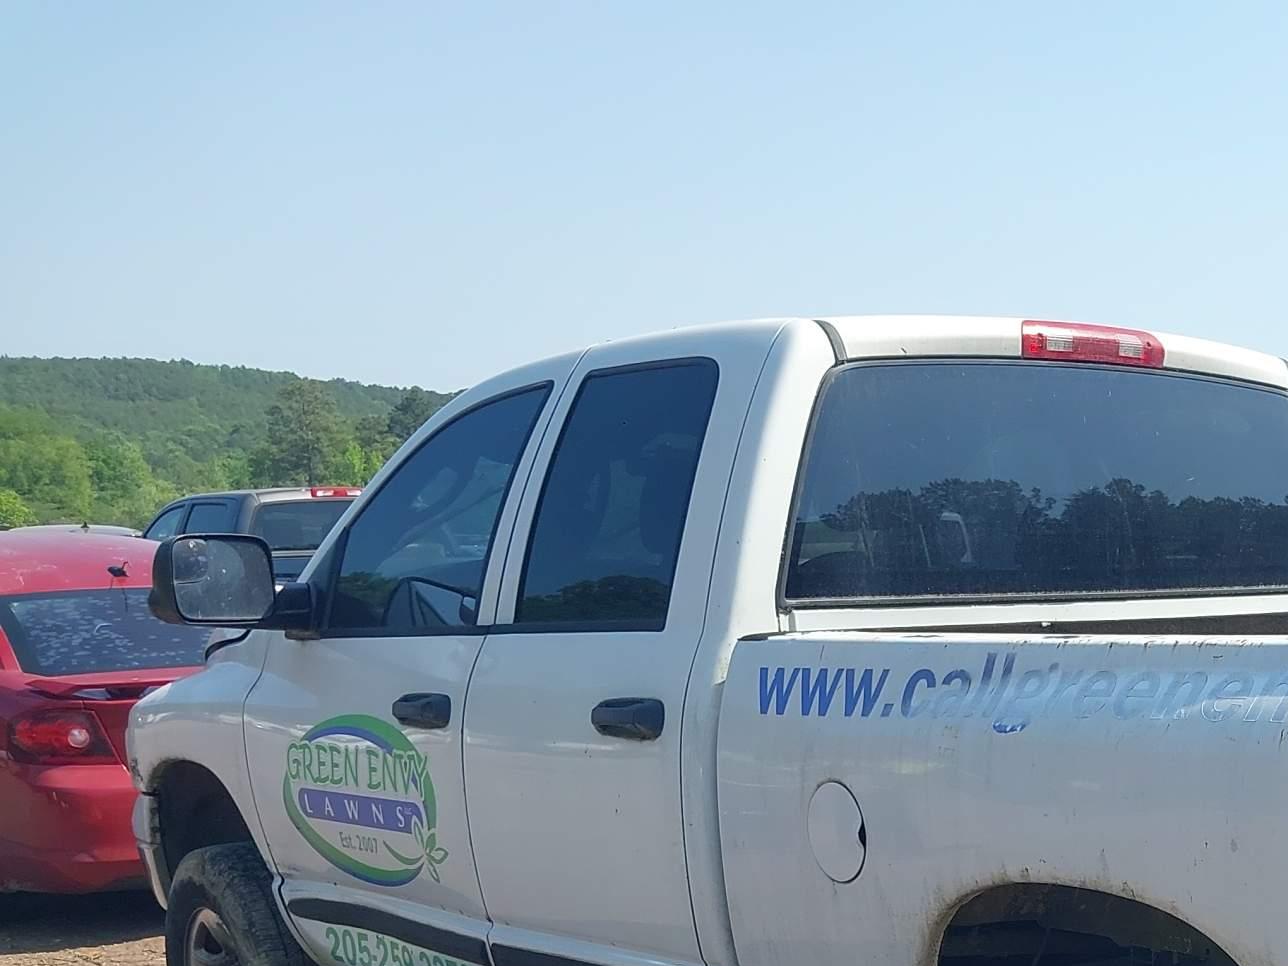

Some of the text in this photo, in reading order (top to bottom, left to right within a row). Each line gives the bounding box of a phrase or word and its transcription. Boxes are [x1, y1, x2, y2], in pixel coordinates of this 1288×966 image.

[286, 740, 428, 799] GREEN ENVY
[304, 793, 405, 828] LAWNS
[339, 831, 378, 854] Est. 2007
